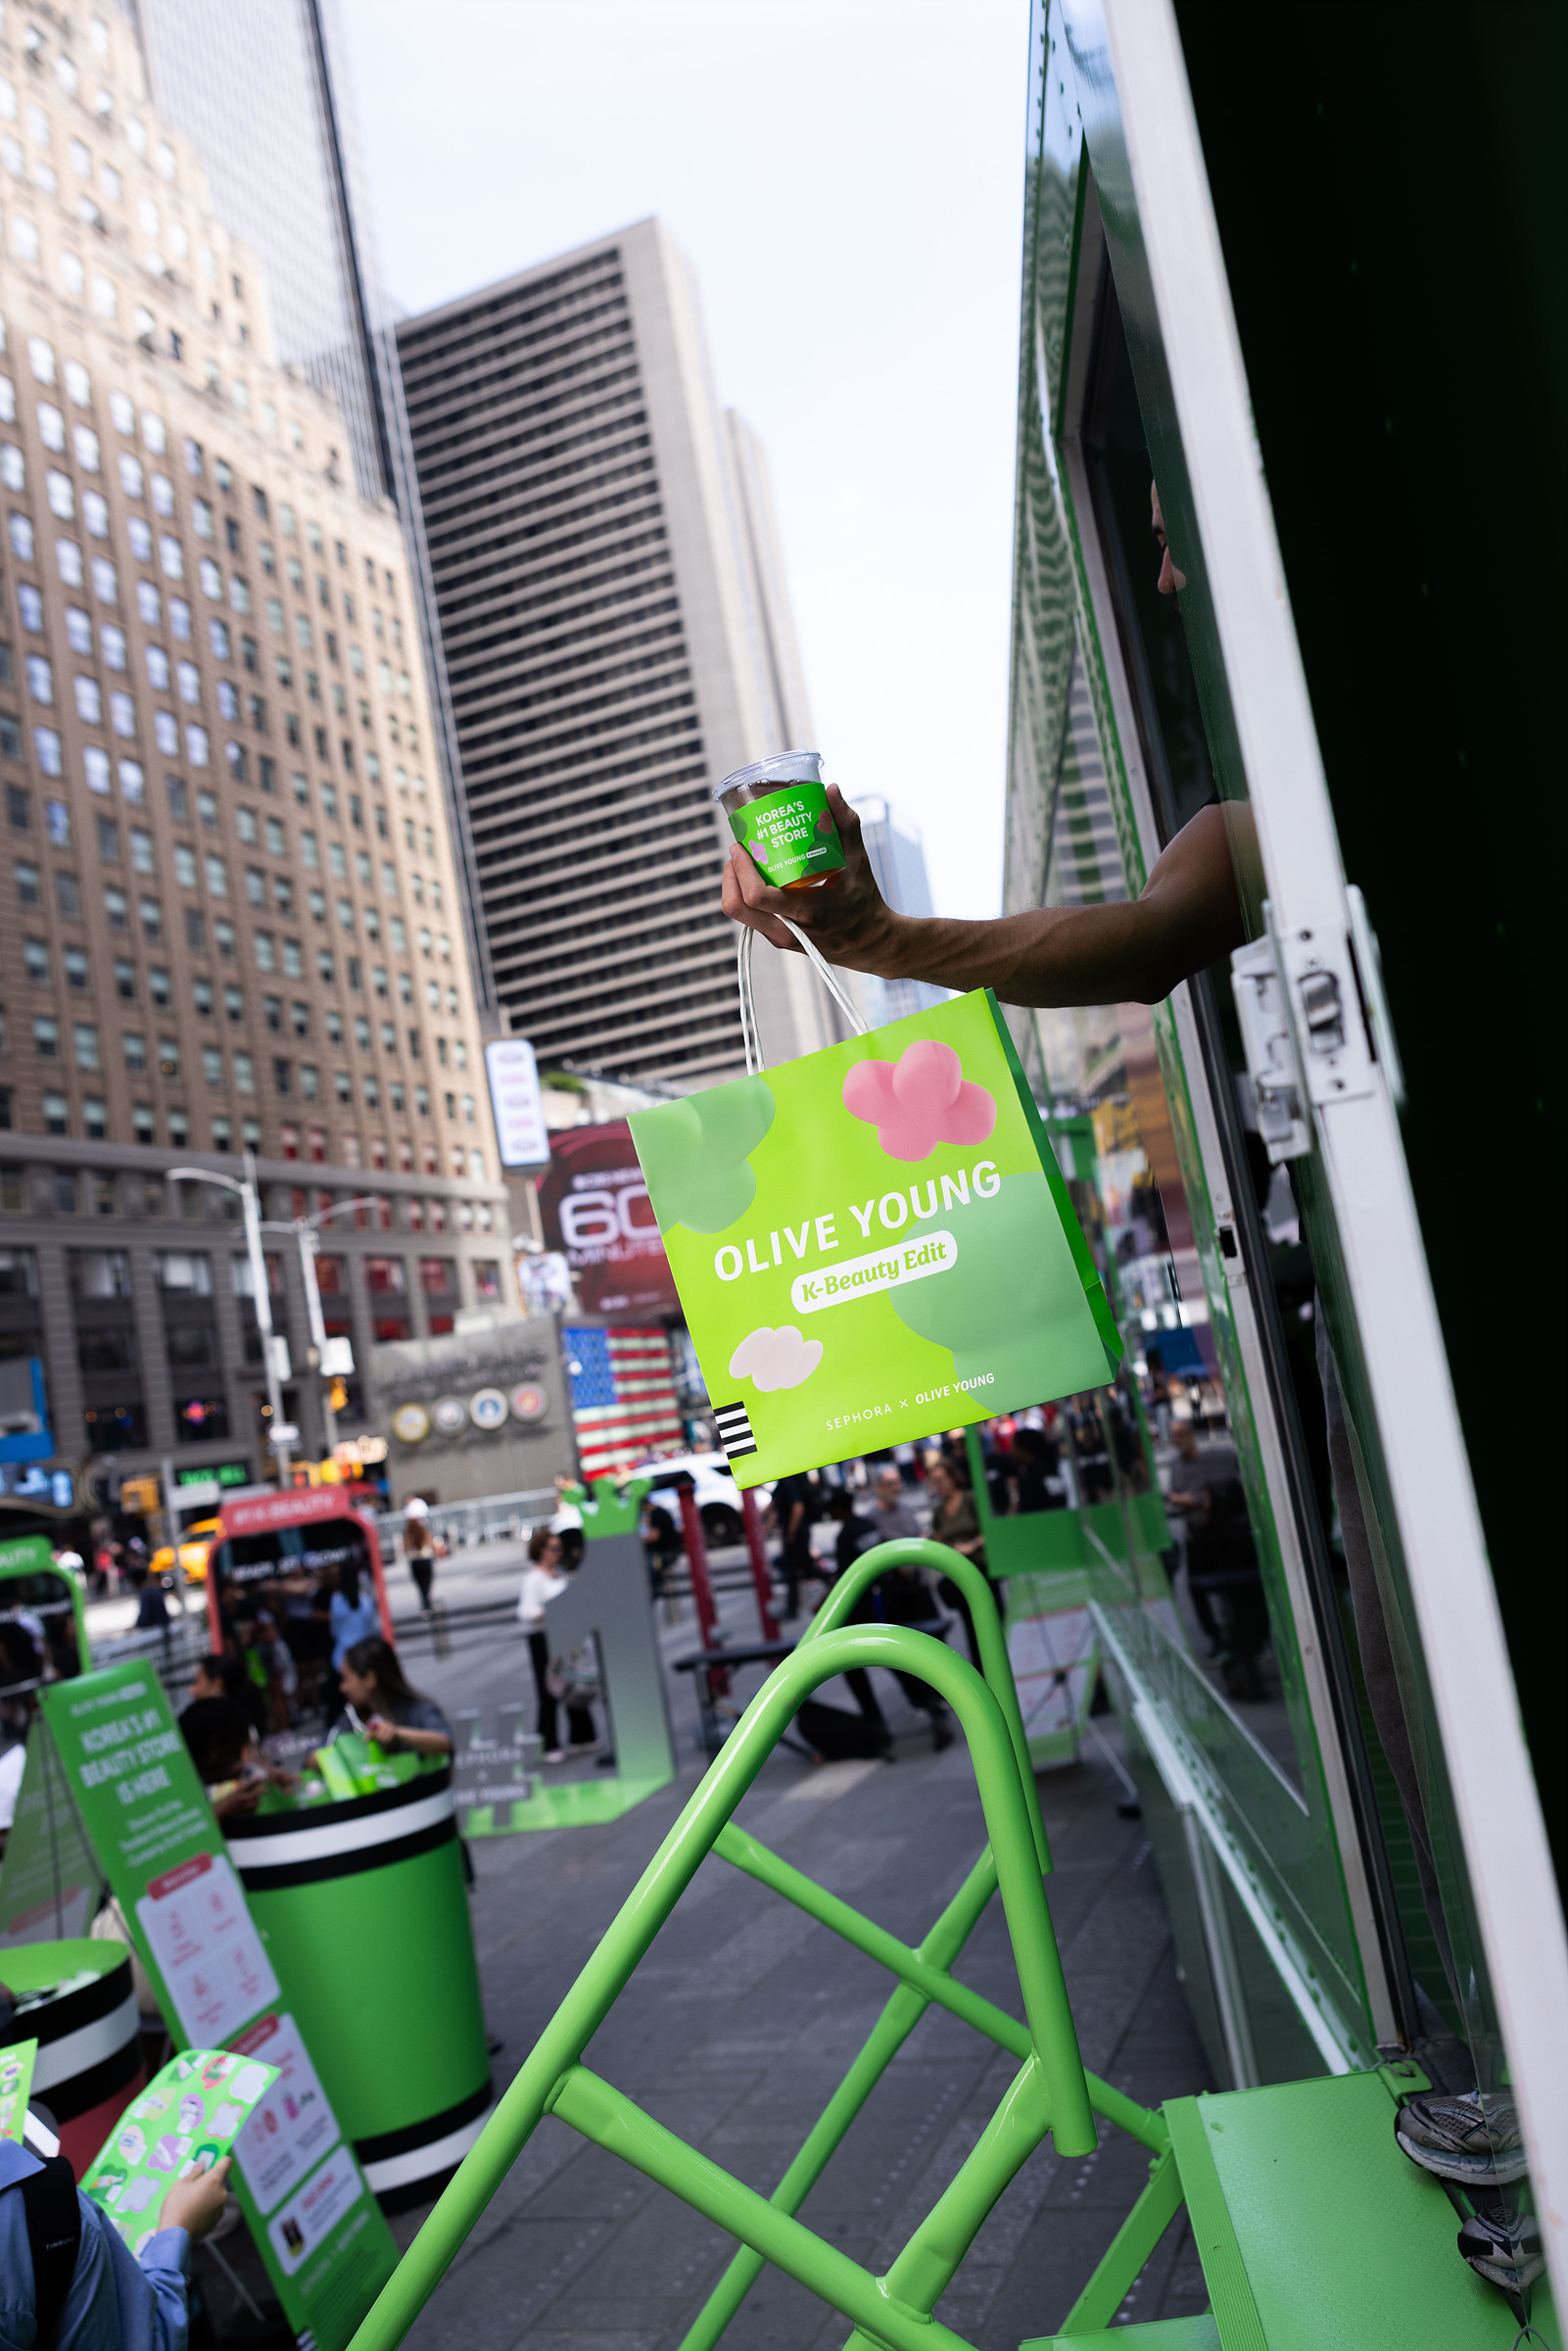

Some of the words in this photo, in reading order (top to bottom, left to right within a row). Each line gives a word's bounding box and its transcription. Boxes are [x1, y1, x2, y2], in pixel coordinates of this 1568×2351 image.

[755, 800, 805, 827] KOREA'S
[756, 828, 770, 840] #1
[769, 811, 813, 836] BEAUTY
[771, 827, 809, 848] STORE
[768, 861, 784, 873] OLIVE
[784, 853, 806, 866] YOUNG
[713, 1212, 839, 1281] OLIVE
[848, 1160, 1001, 1238] YOUNG
[566, 1238, 667, 1267] MINUTE
[801, 1258, 900, 1303] K-Beauty
[902, 1240, 947, 1271] Edit
[826, 1403, 892, 1431] SEPHORA
[915, 1385, 951, 1405] OLIVE
[952, 1372, 995, 1394] YOUNG
